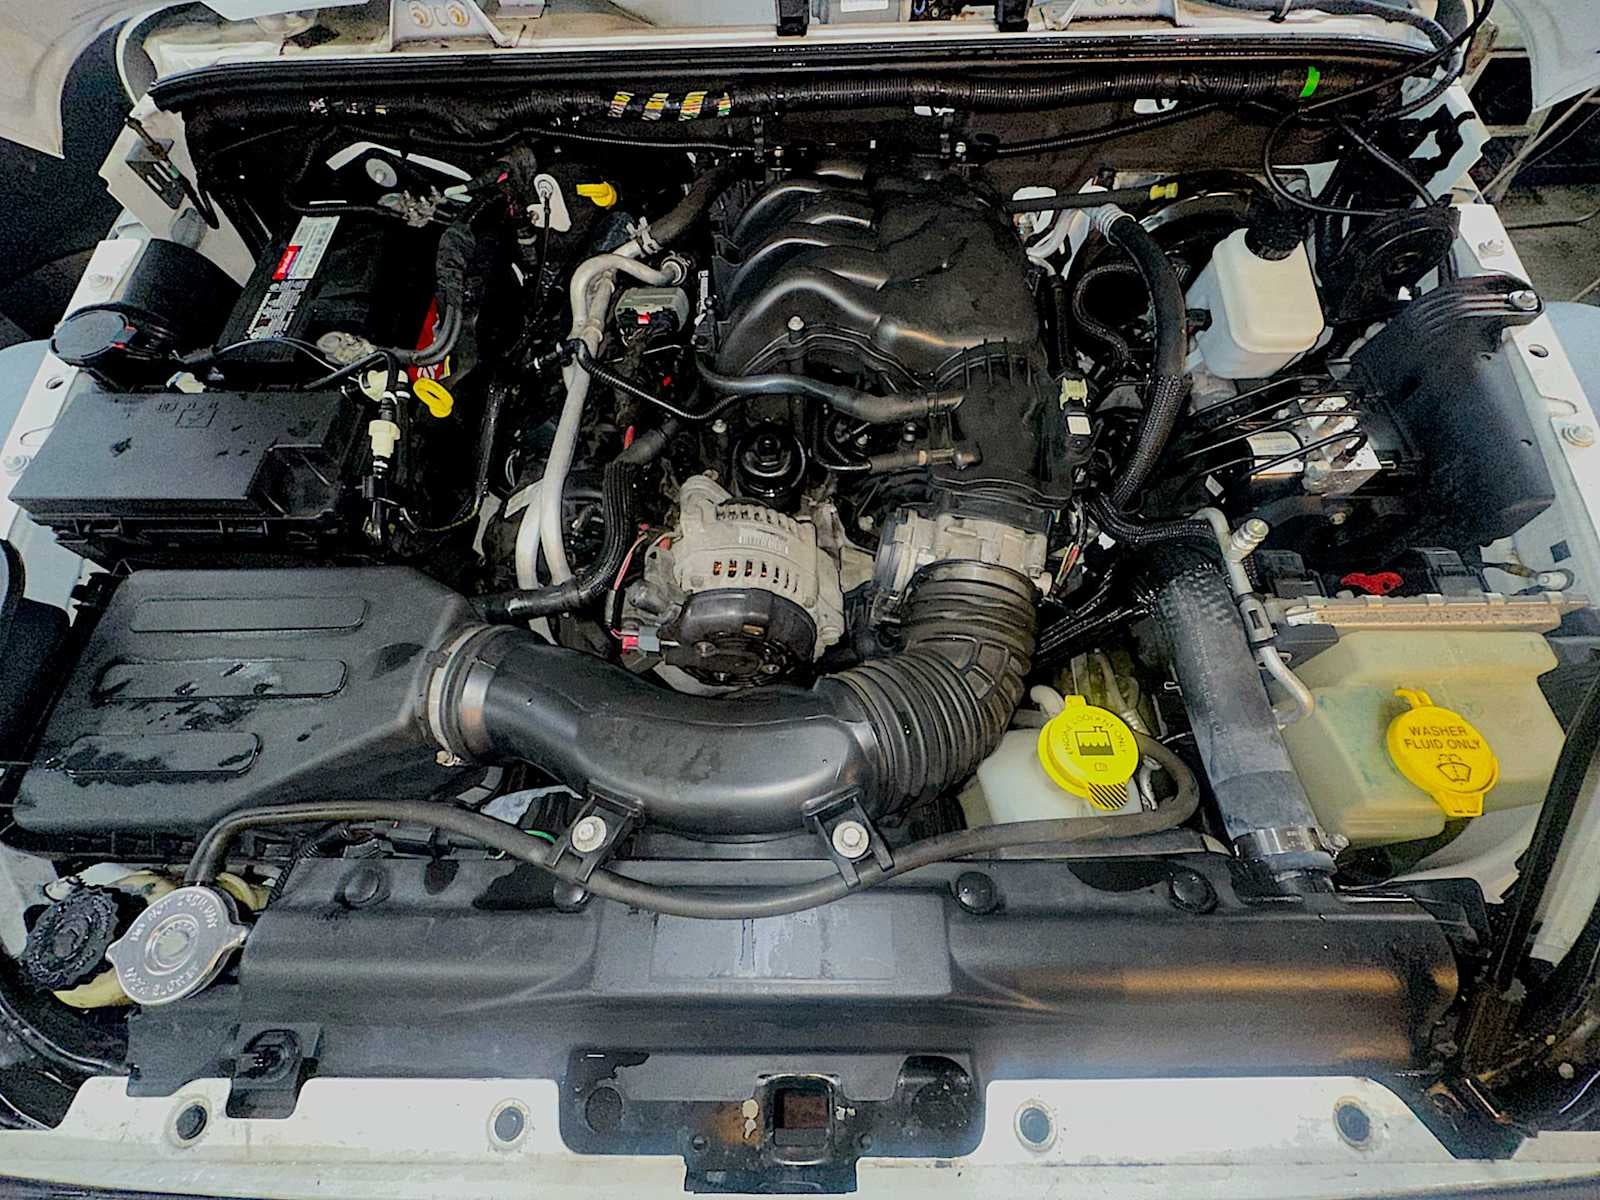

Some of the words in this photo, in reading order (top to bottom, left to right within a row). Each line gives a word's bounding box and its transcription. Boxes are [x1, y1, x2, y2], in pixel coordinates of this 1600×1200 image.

[1408, 725, 1468, 737] WASHER
[1404, 738, 1444, 750] FLUID
[1447, 739, 1481, 750] ONLY
